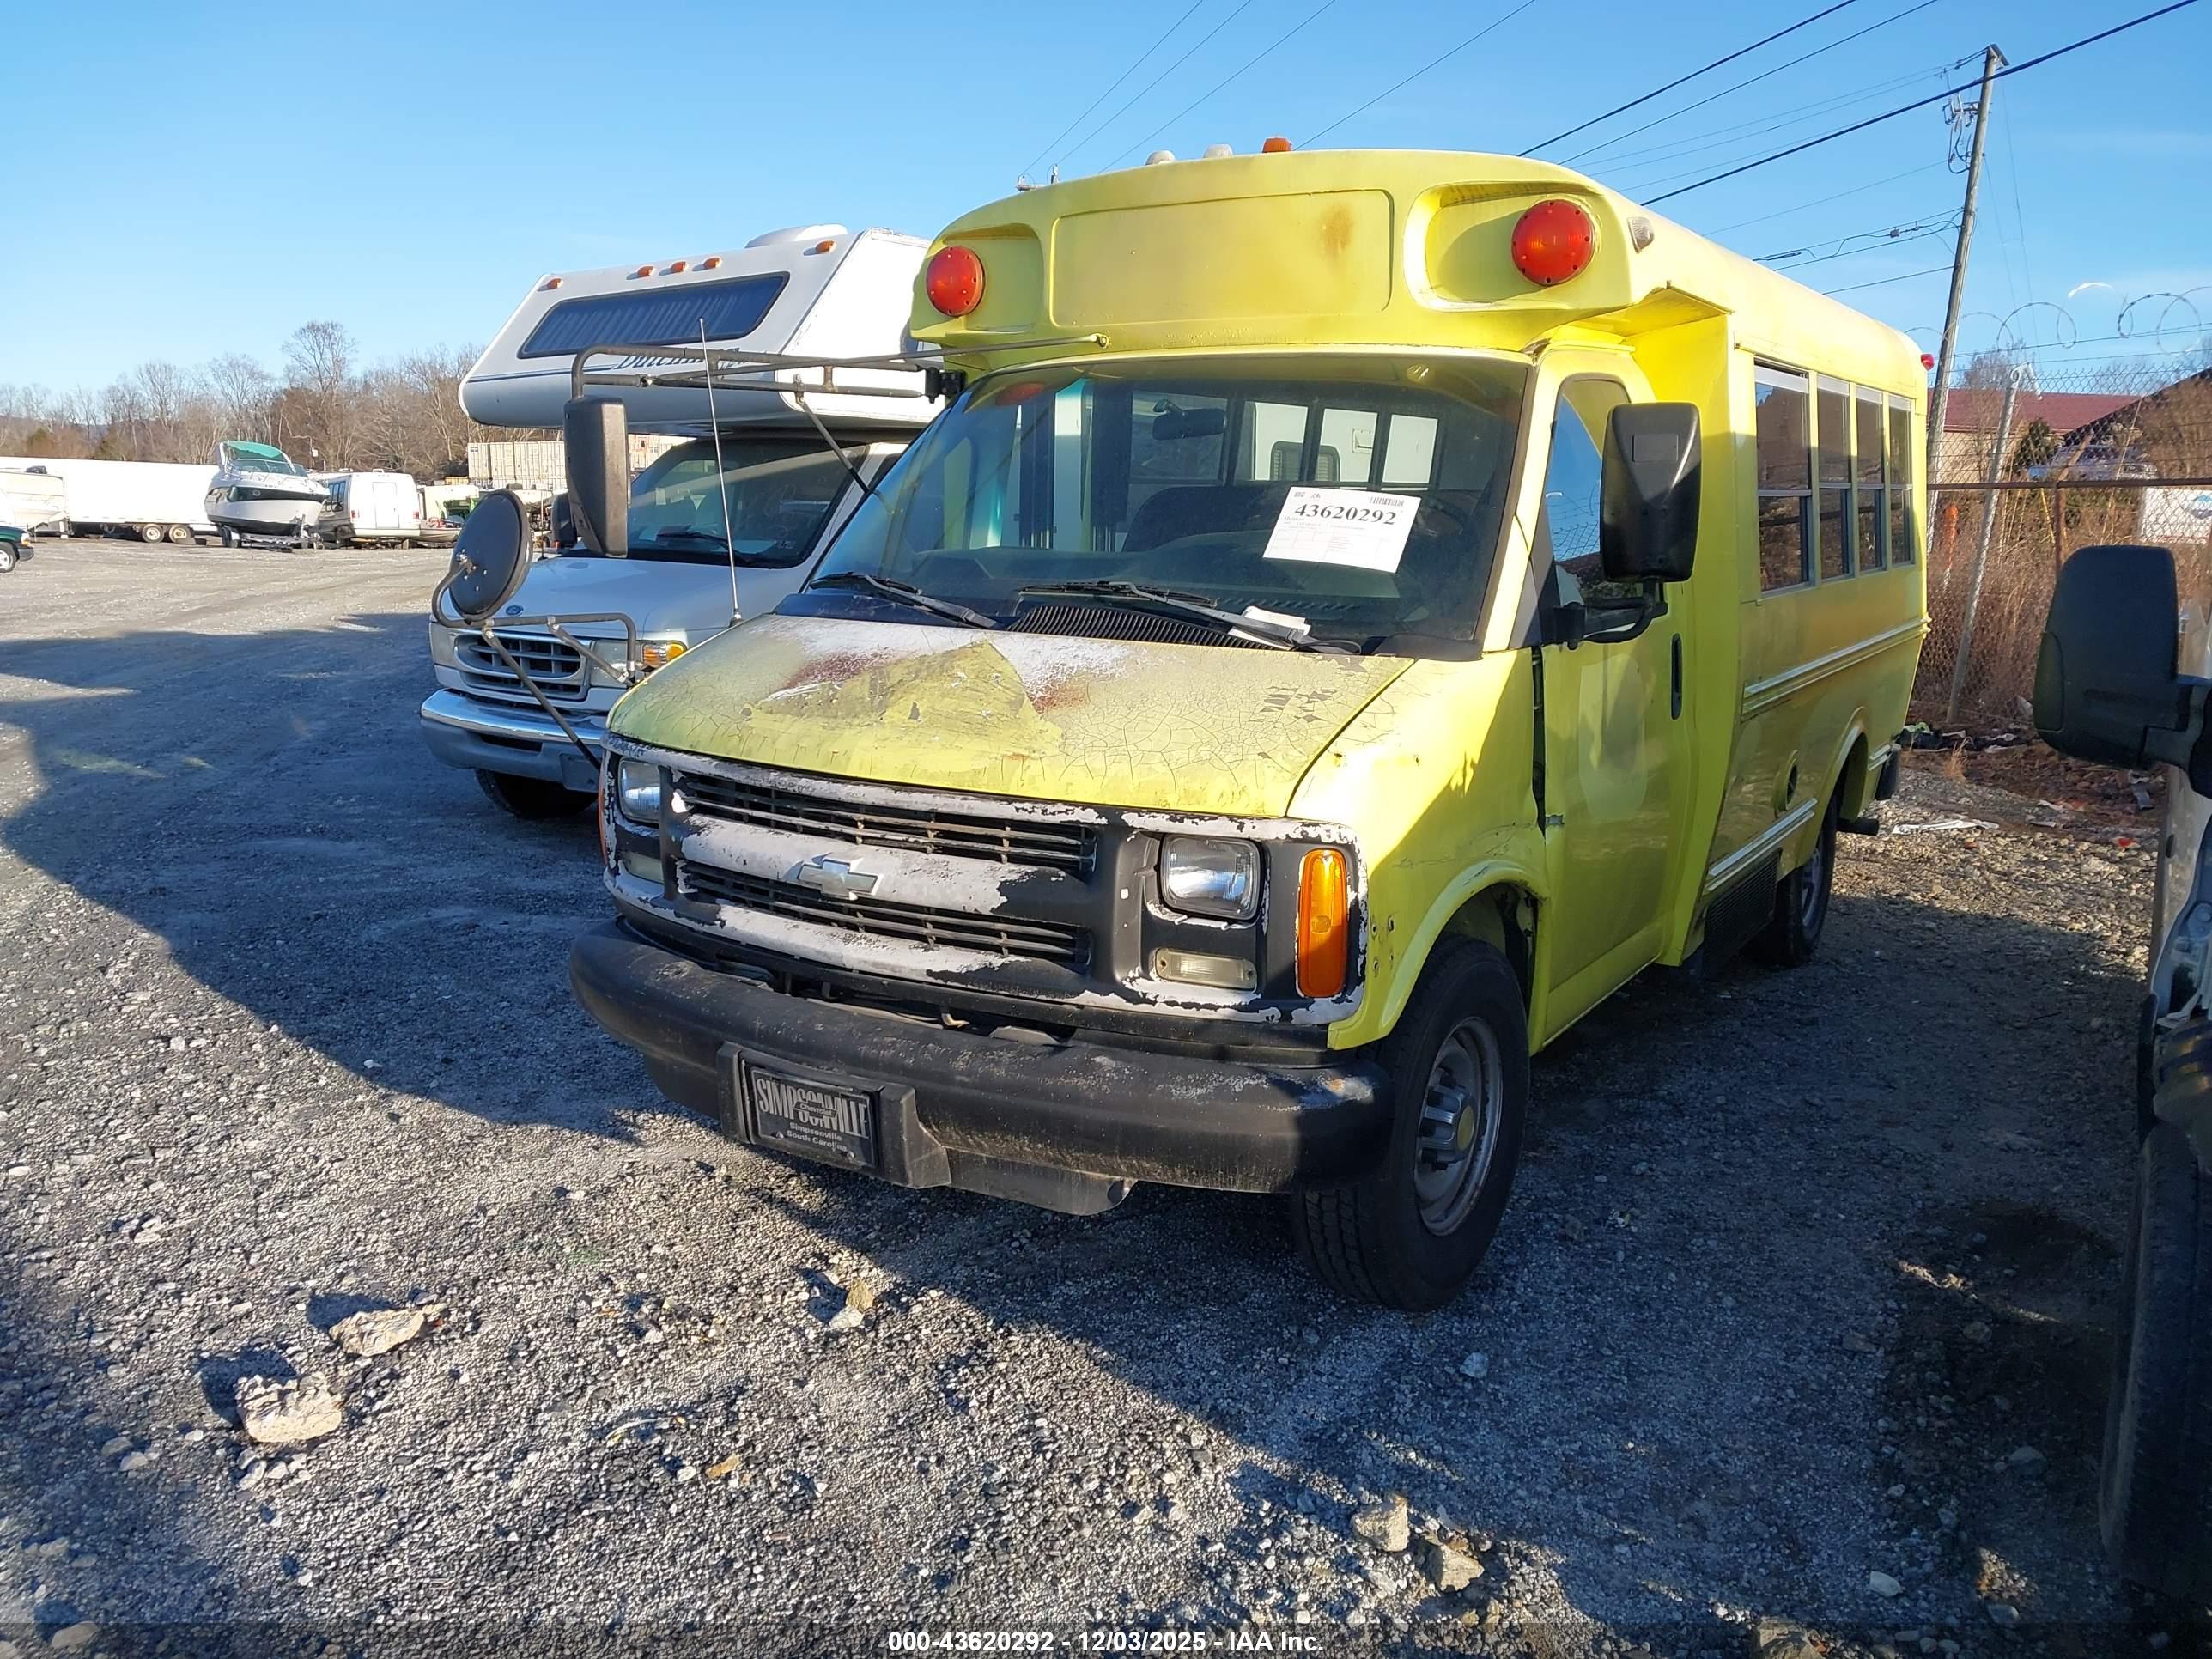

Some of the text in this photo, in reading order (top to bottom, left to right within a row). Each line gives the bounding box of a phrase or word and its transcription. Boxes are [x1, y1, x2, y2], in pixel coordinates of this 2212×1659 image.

[1294, 503, 1397, 525] 43620292
[799, 1103, 834, 1116] Chevrolet
[787, 1130, 848, 1152] South Carolina
[789, 1121, 842, 1141] Simpsonville
